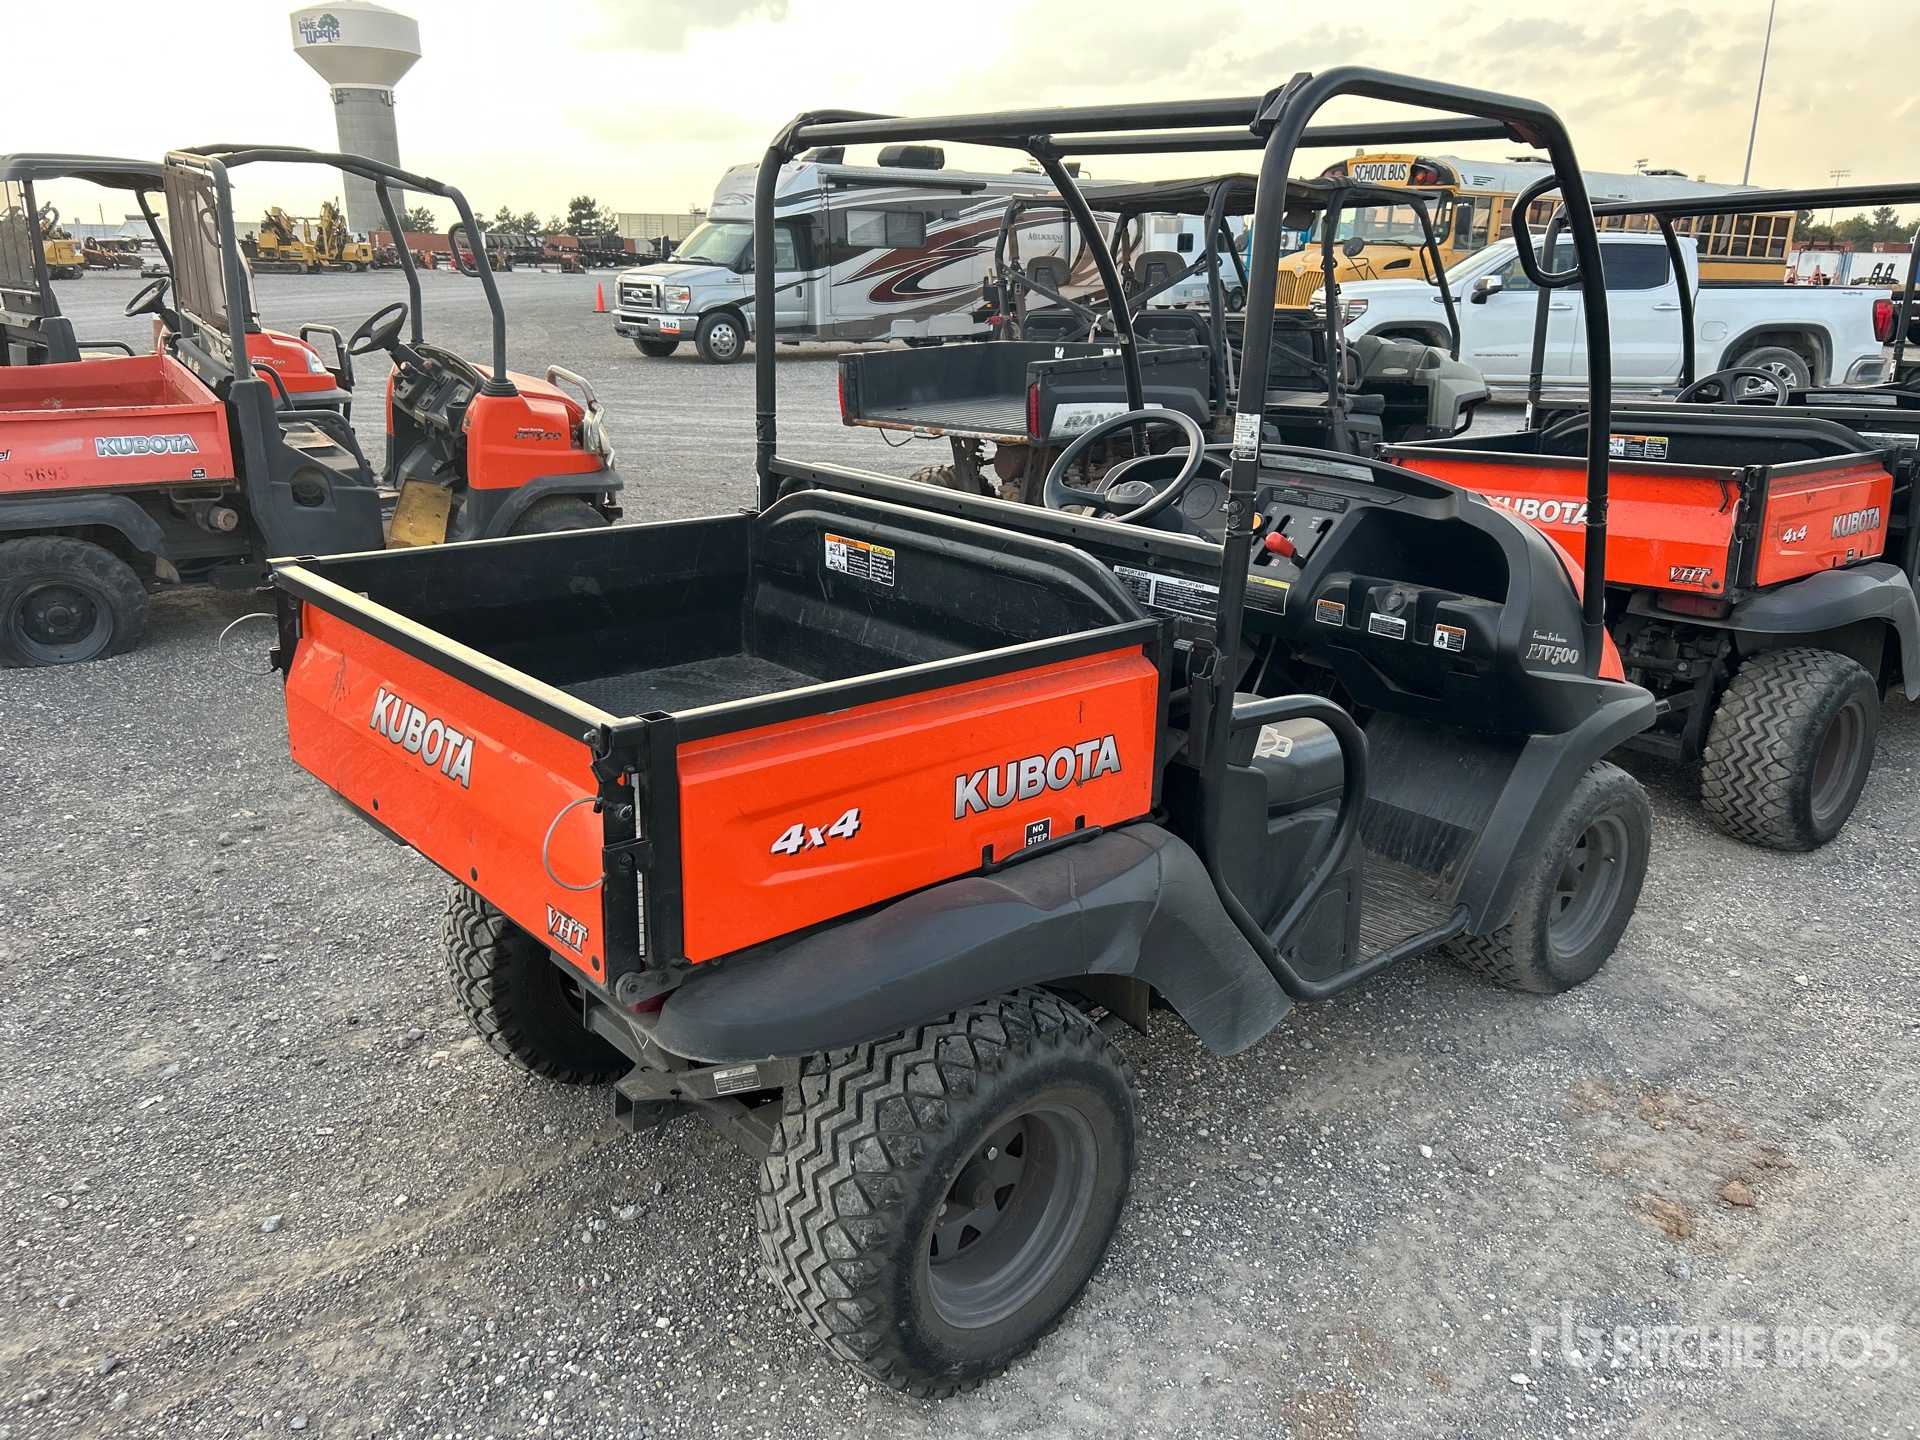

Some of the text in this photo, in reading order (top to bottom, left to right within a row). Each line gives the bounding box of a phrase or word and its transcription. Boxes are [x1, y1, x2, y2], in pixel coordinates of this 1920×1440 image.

[1354, 164, 1407, 181] SCHOOL BUS
[662, 321, 677, 329] 1842
[95, 434, 199, 457] KUBOTA
[1831, 506, 1880, 539] KUBOTA
[1783, 525, 1808, 544] 4x4
[1118, 567, 1148, 579] IMPORTANT
[1669, 566, 1712, 583] VHT
[1177, 579, 1205, 590] IMPORTANT
[1526, 644, 1579, 665] RTV500
[370, 687, 476, 789] KUBOTA
[954, 735, 1121, 820] KUBOTA
[770, 808, 862, 855] 4x4
[1032, 823, 1044, 834] NO
[1027, 832, 1048, 846] STEP
[546, 903, 588, 953] VHT
